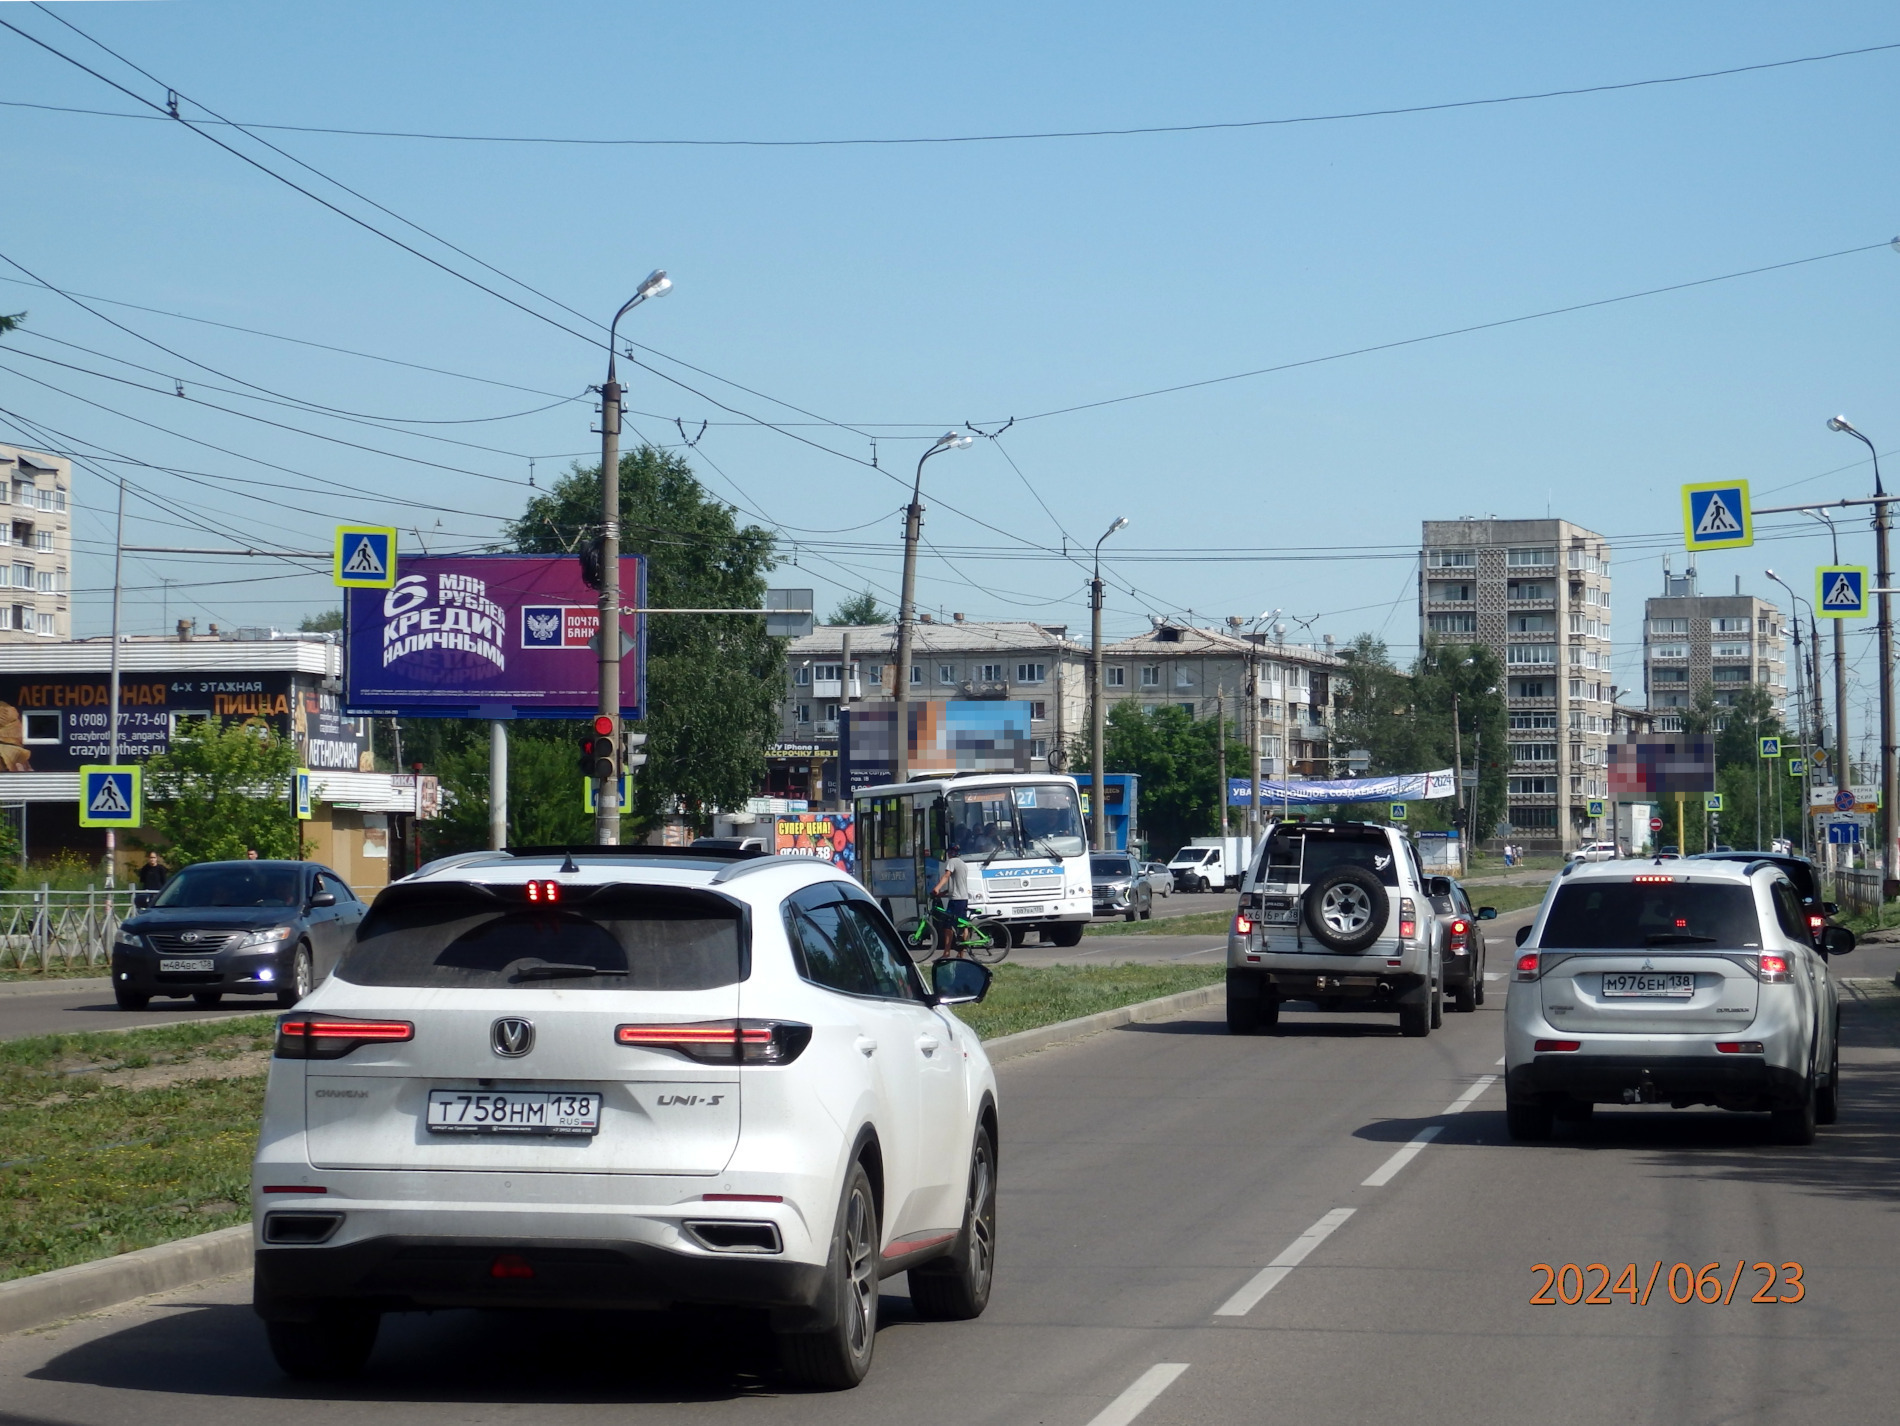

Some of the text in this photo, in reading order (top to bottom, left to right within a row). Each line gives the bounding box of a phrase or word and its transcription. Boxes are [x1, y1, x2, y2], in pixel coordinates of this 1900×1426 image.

[384, 574, 485, 617] 6 МЛН
[439, 590, 505, 629] РУБЛЕЙ
[384, 608, 505, 648] КРЕДИТ
[567, 616, 600, 626] ПОЧТА
[567, 628, 595, 638] БАНК
[383, 632, 504, 672] НАЛИЧНЫМИ
[171, 681, 263, 692] 4-Х ЭТАЖНАЯ
[18, 684, 167, 706] ЛЕГЕНДАНАЯ
[213, 694, 289, 716] ПИЦЦА
[69, 713, 167, 727] 8 (908) 77-73-60
[69, 731, 166, 743] crazybrotrs_angarsk
[308, 739, 358, 769] ЛЕГЕНДАРНАЯ
[1016, 791, 1034, 804] 27
[778, 822, 831, 836] СУПЕР ЦЕНА!
[994, 868, 1055, 876] АНГАРСК
[1247, 910, 1285, 920] Х66РТ
[1606, 975, 1690, 990] М976ЕН 138
[439, 1096, 591, 1123] Т758НМ 138
